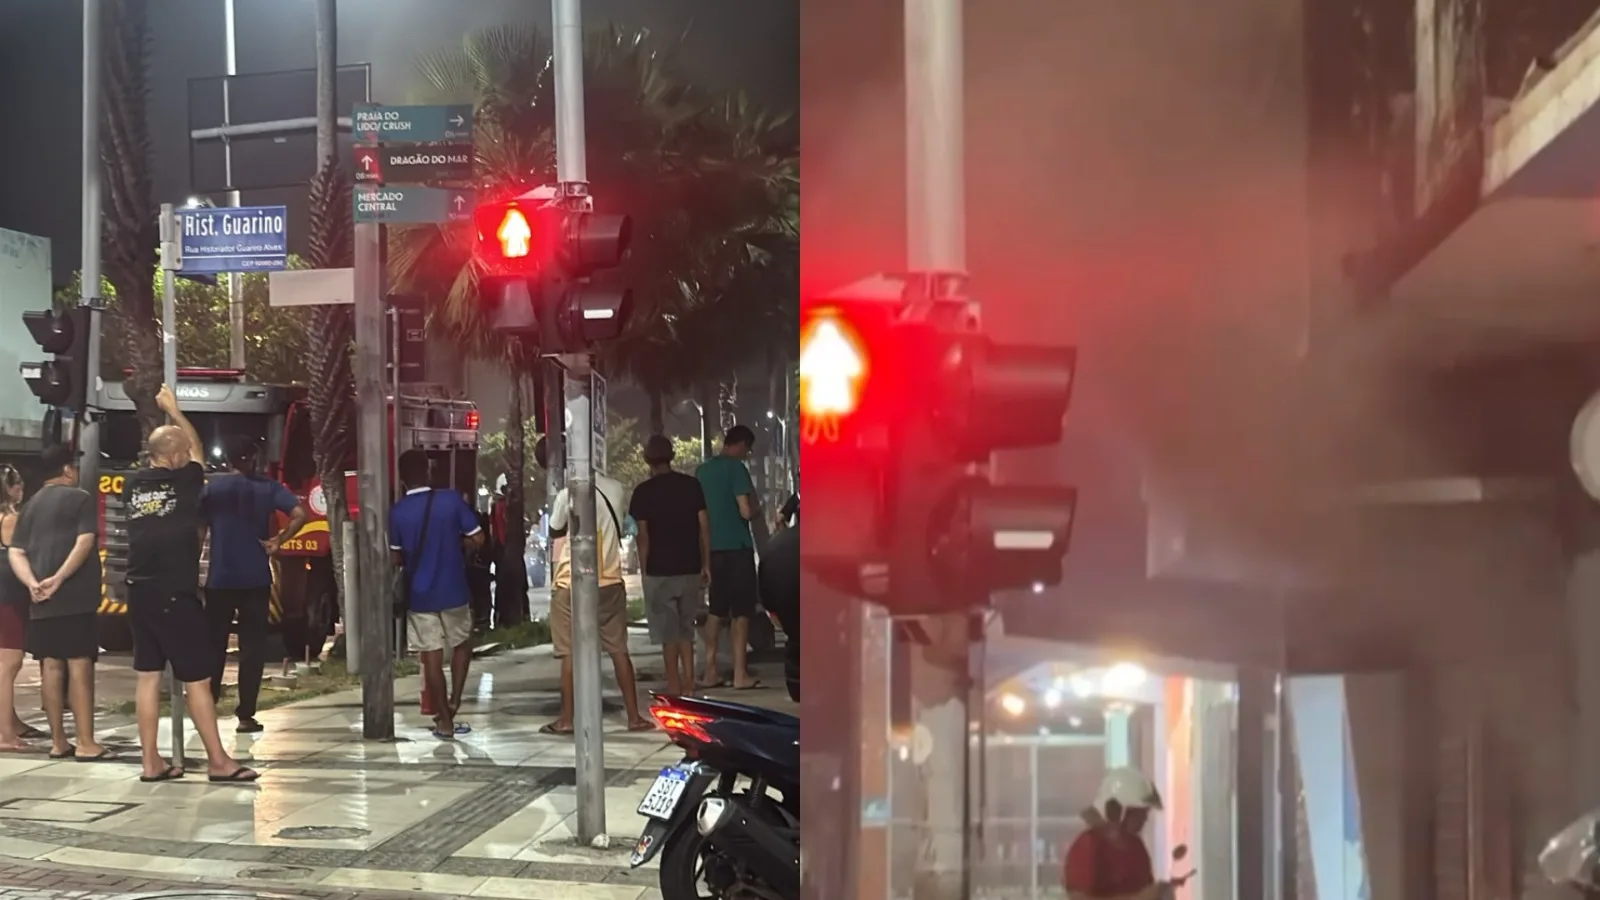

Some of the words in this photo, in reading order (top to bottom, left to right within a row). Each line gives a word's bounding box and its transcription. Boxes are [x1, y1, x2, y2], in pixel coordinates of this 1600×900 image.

[357, 112, 382, 120] PRAIA
[385, 112, 399, 120] DO
[357, 122, 381, 132] LIDO/
[383, 121, 411, 130] CRUSH
[390, 153, 430, 165] DRAGÃO
[431, 155, 446, 164] DO
[447, 155, 468, 164] MAR
[357, 192, 403, 201] MERCADO
[357, 202, 397, 212] CENTRAL
[222, 210, 282, 235] Guarino
[185, 245, 199, 253] Rua
[305, 540, 318, 551] 03
